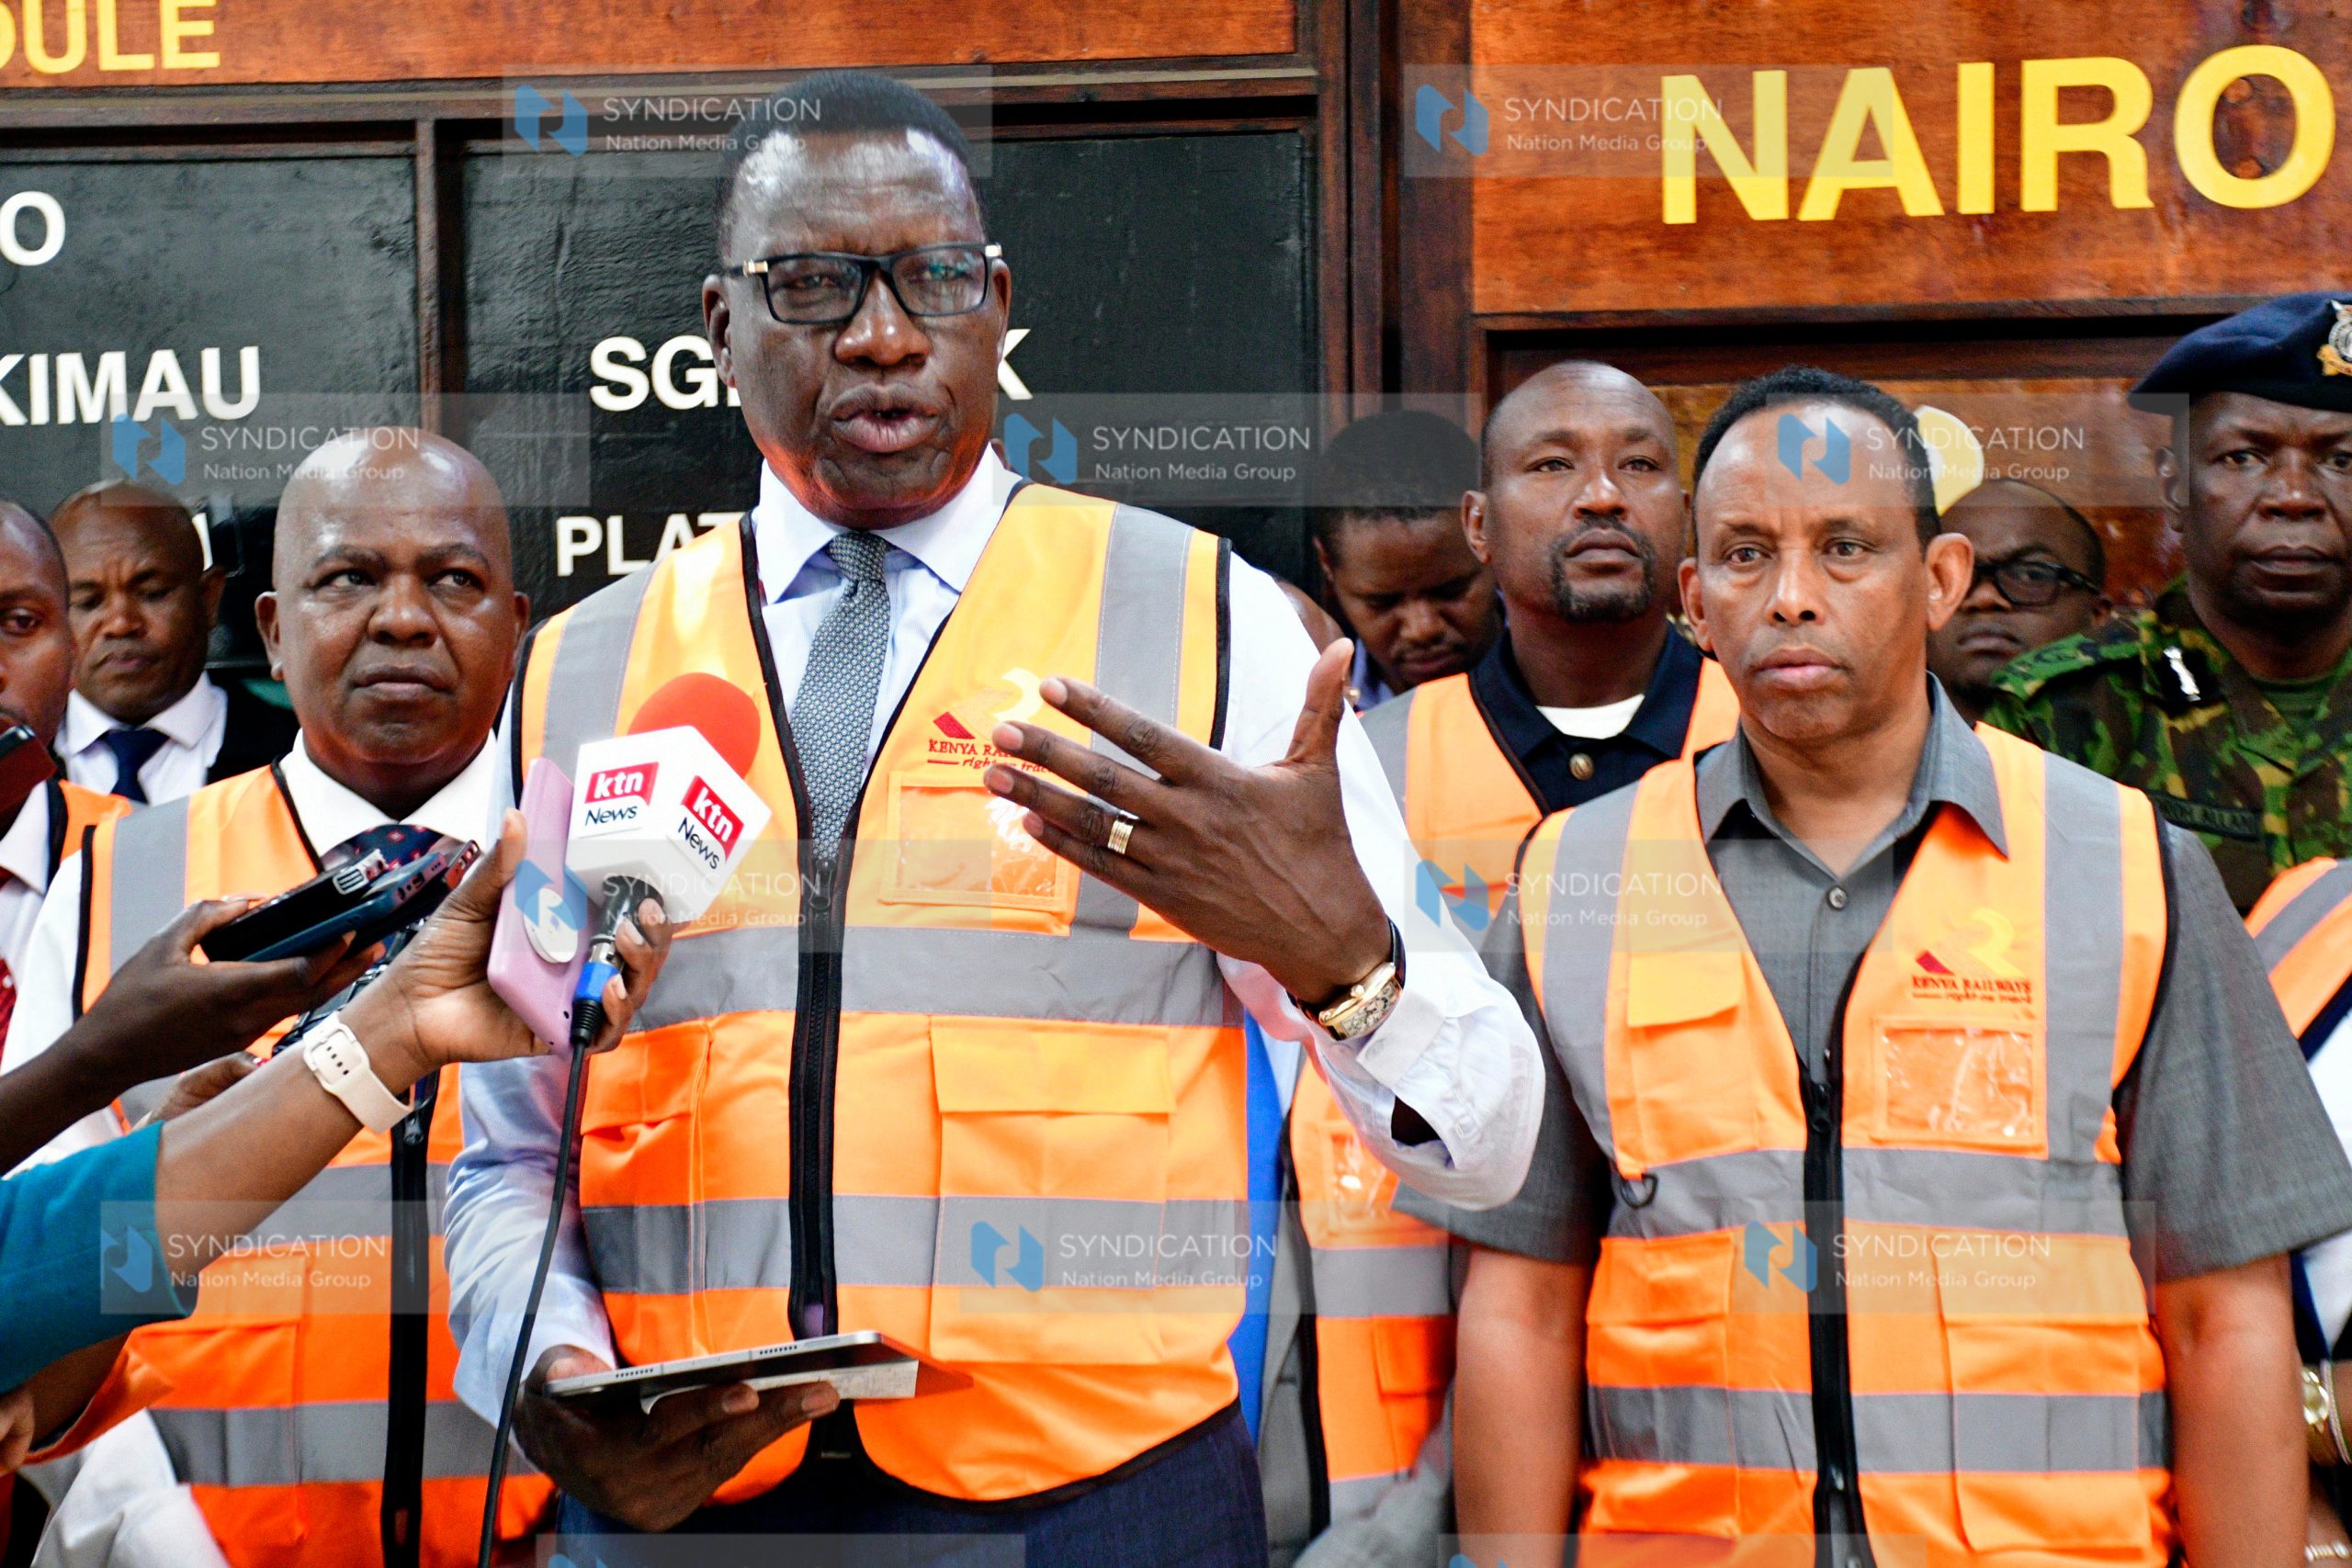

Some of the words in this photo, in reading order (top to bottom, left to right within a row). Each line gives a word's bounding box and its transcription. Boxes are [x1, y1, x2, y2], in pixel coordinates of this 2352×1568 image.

[0, 0, 220, 73] ULE
[1660, 45, 2336, 224] NAIRO
[590, 334, 741, 412] SG
[929, 739, 978, 756] KENYA
[594, 771, 644, 799] ktn
[584, 806, 638, 826] News
[692, 786, 733, 843] ktn
[677, 817, 720, 870] News
